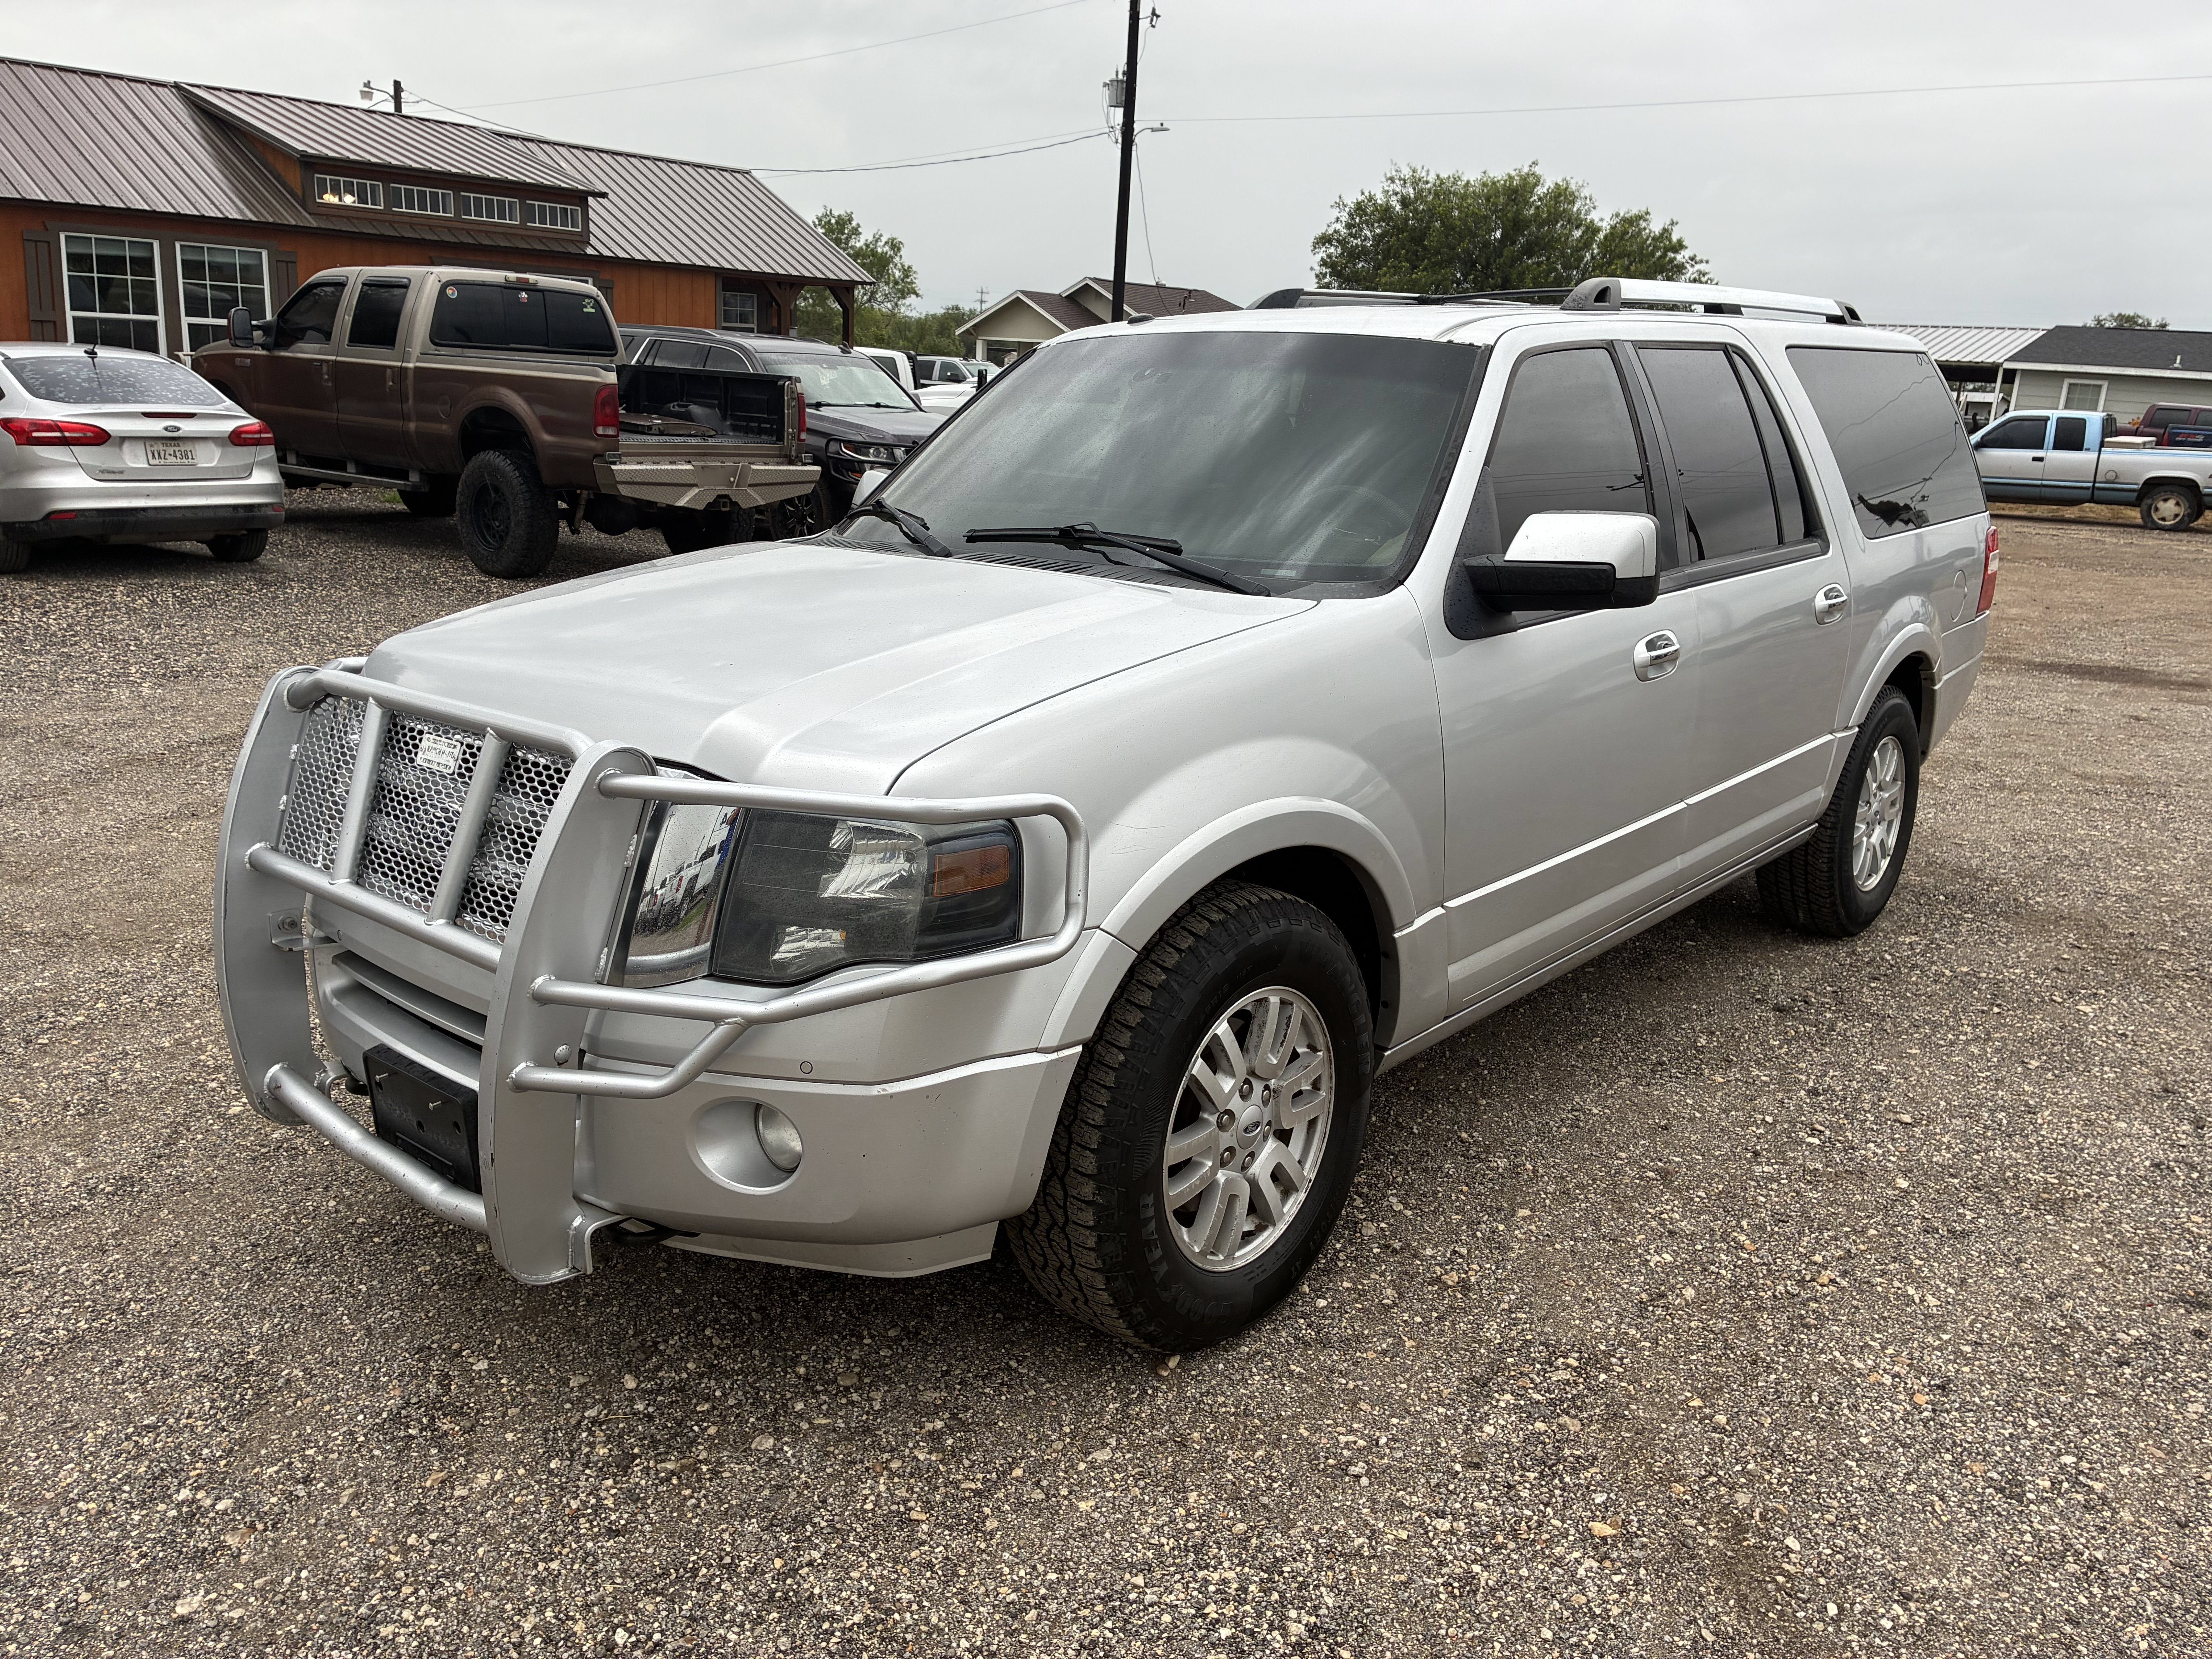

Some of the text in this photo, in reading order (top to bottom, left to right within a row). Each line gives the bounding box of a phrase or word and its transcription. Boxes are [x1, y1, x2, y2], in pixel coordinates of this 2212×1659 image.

[151, 449, 195, 460] XXZ 4381
[1247, 1124, 1257, 1132] Ford
[1140, 1192, 1233, 1324] GOODYEAR
